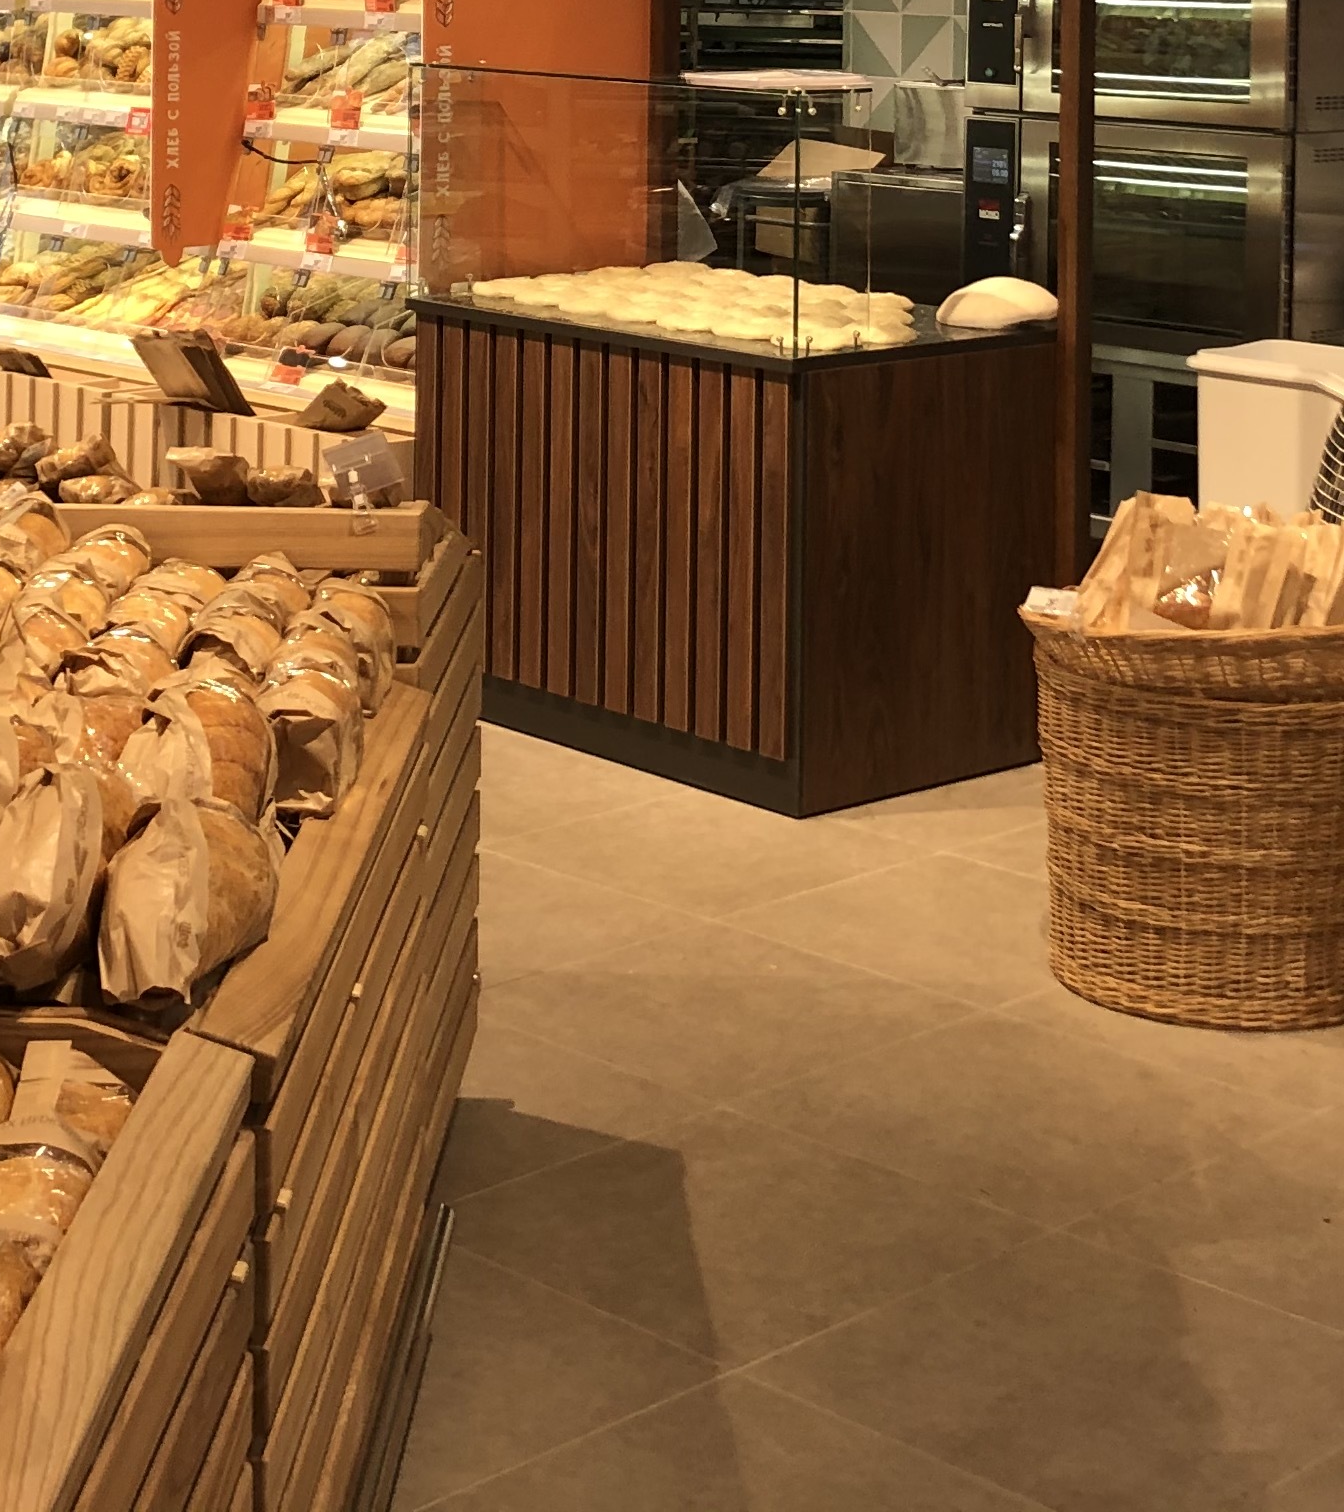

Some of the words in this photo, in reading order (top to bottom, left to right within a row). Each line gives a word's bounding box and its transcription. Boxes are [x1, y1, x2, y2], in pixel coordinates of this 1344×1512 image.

[165, 30, 181, 102] ПОЛЬЗОЙ
[167, 109, 180, 120] С
[166, 127, 180, 169] ХЛЕБ
[436, 152, 451, 197] ХЛЕБ
